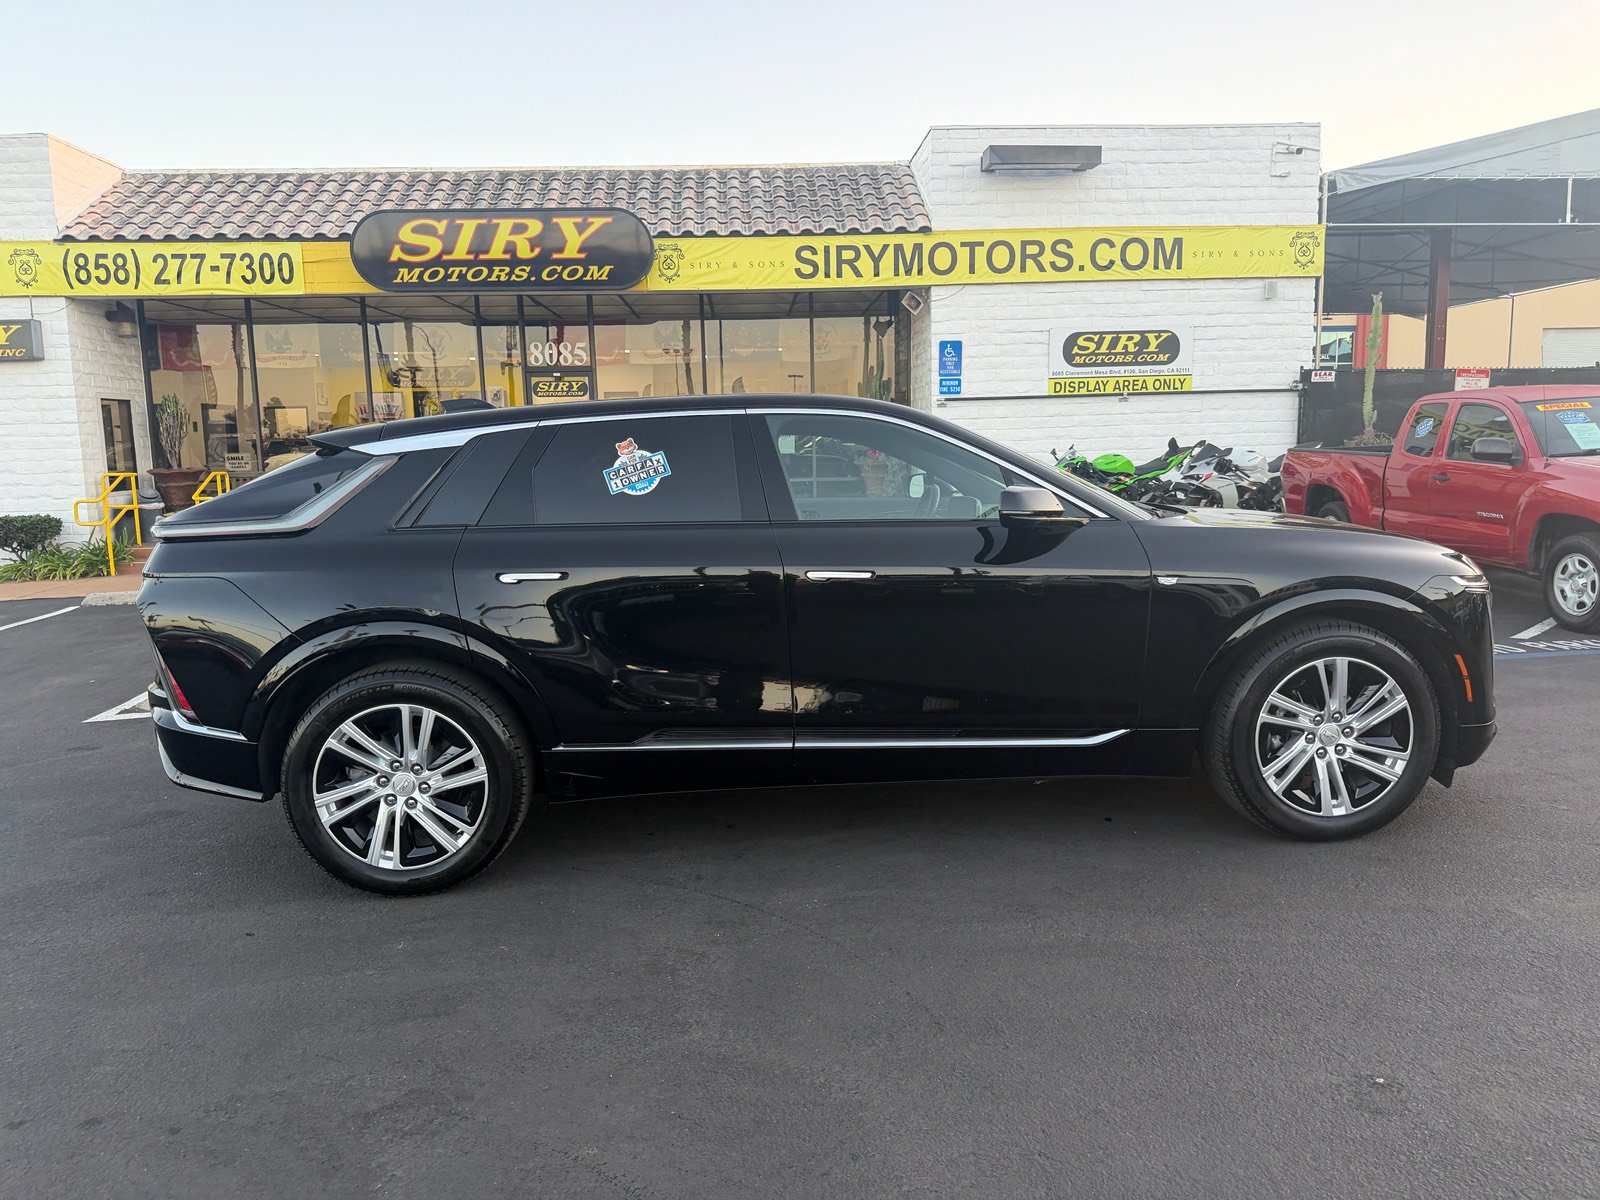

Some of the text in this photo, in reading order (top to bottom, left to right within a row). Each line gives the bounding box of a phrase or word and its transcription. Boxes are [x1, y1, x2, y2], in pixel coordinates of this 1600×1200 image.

[388, 216, 613, 263] SIRY
[689, 260, 786, 270] SIRY & SONS
[794, 237, 1286, 280] SIRYMOTORS.COM SIRY & SONS
[62, 248, 295, 290] (858) 277-7300
[392, 264, 614, 283] MOTORS.COM
[1071, 332, 1172, 354] SIRY
[529, 341, 587, 366] 8085
[1072, 354, 1171, 364] MOTORS.COM
[536, 381, 584, 392] SIRY
[1053, 377, 1187, 394] DISPLAY AREA ONLY
[609, 457, 663, 479] CARFAX
[622, 466, 665, 486] OWNER
[1476, 511, 1504, 519] TACOMA
